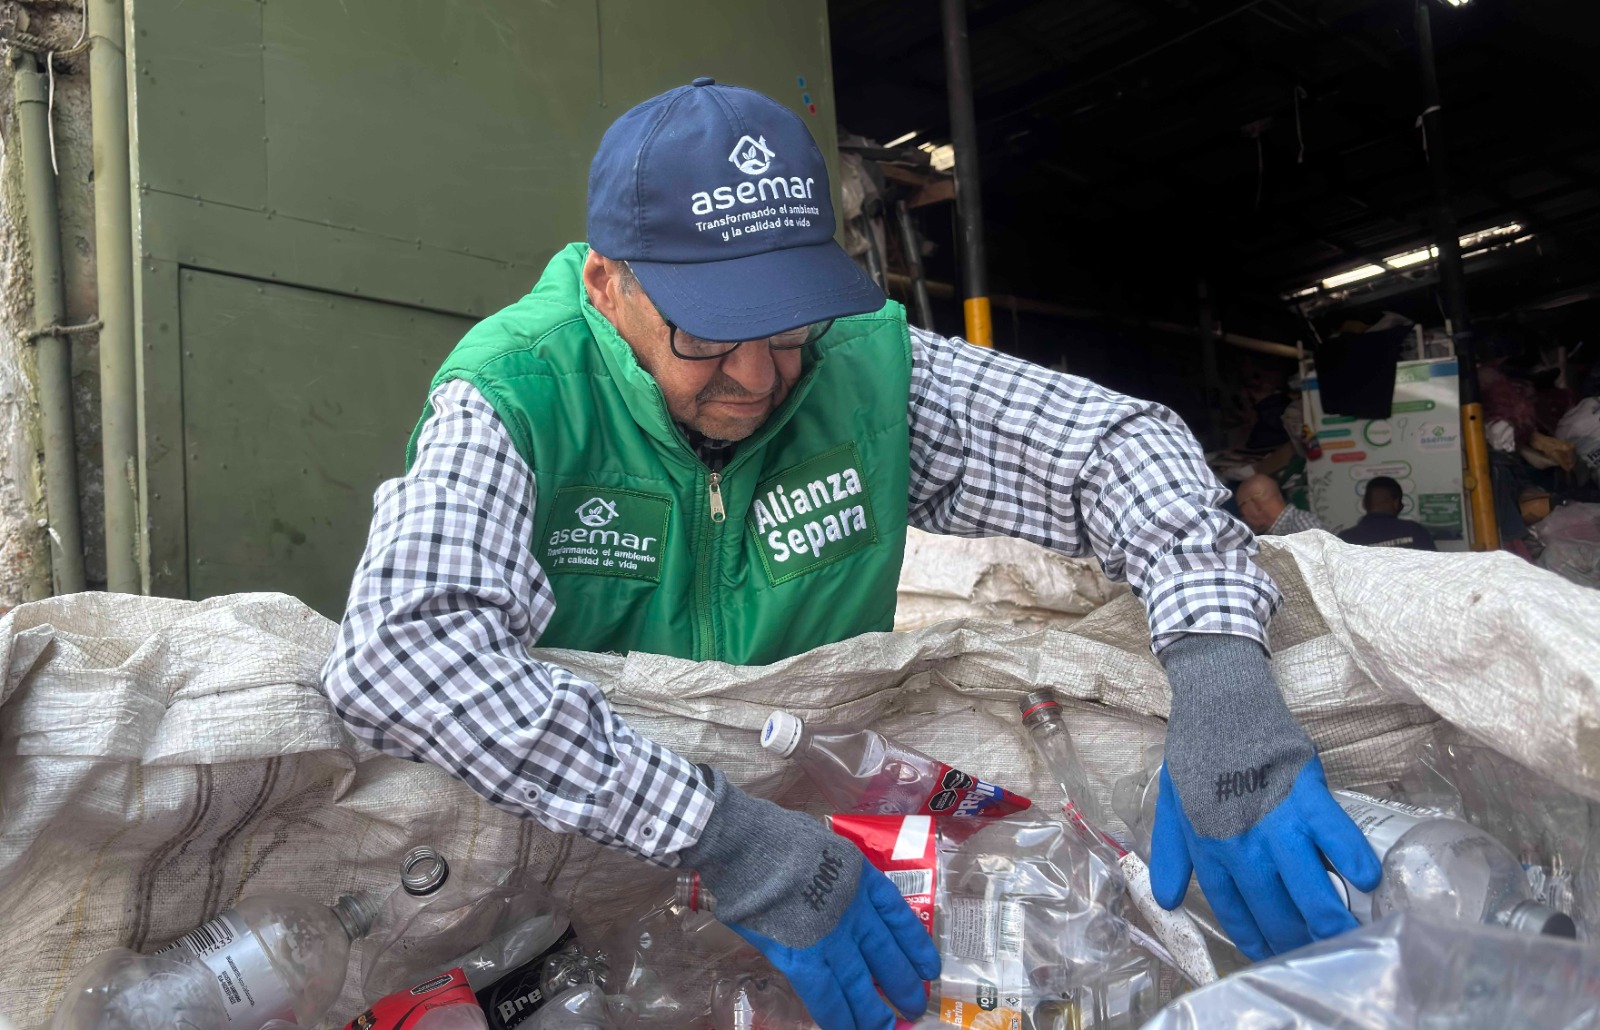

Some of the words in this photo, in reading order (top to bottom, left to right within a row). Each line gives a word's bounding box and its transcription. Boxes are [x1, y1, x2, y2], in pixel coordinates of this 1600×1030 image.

[691, 176, 814, 215] asemar
[696, 206, 776, 232] Transformando
[779, 204, 787, 214] el
[788, 204, 819, 216] ambiente
[722, 230, 729, 241] y
[732, 226, 742, 237] la
[745, 218, 782, 233] calidad
[784, 218, 794, 226] de
[796, 217, 811, 227] vida
[752, 467, 862, 534] Alianza
[549, 528, 657, 551] asemar
[766, 504, 868, 562] Separa
[547, 546, 598, 557] Transformando
[602, 548, 610, 557] el
[614, 549, 656, 563] ambiente
[553, 559, 558, 567] y
[567, 556, 599, 566] calidad
[602, 558, 614, 567] de
[619, 560, 638, 570] vida
[497, 988, 542, 1024] Bre
